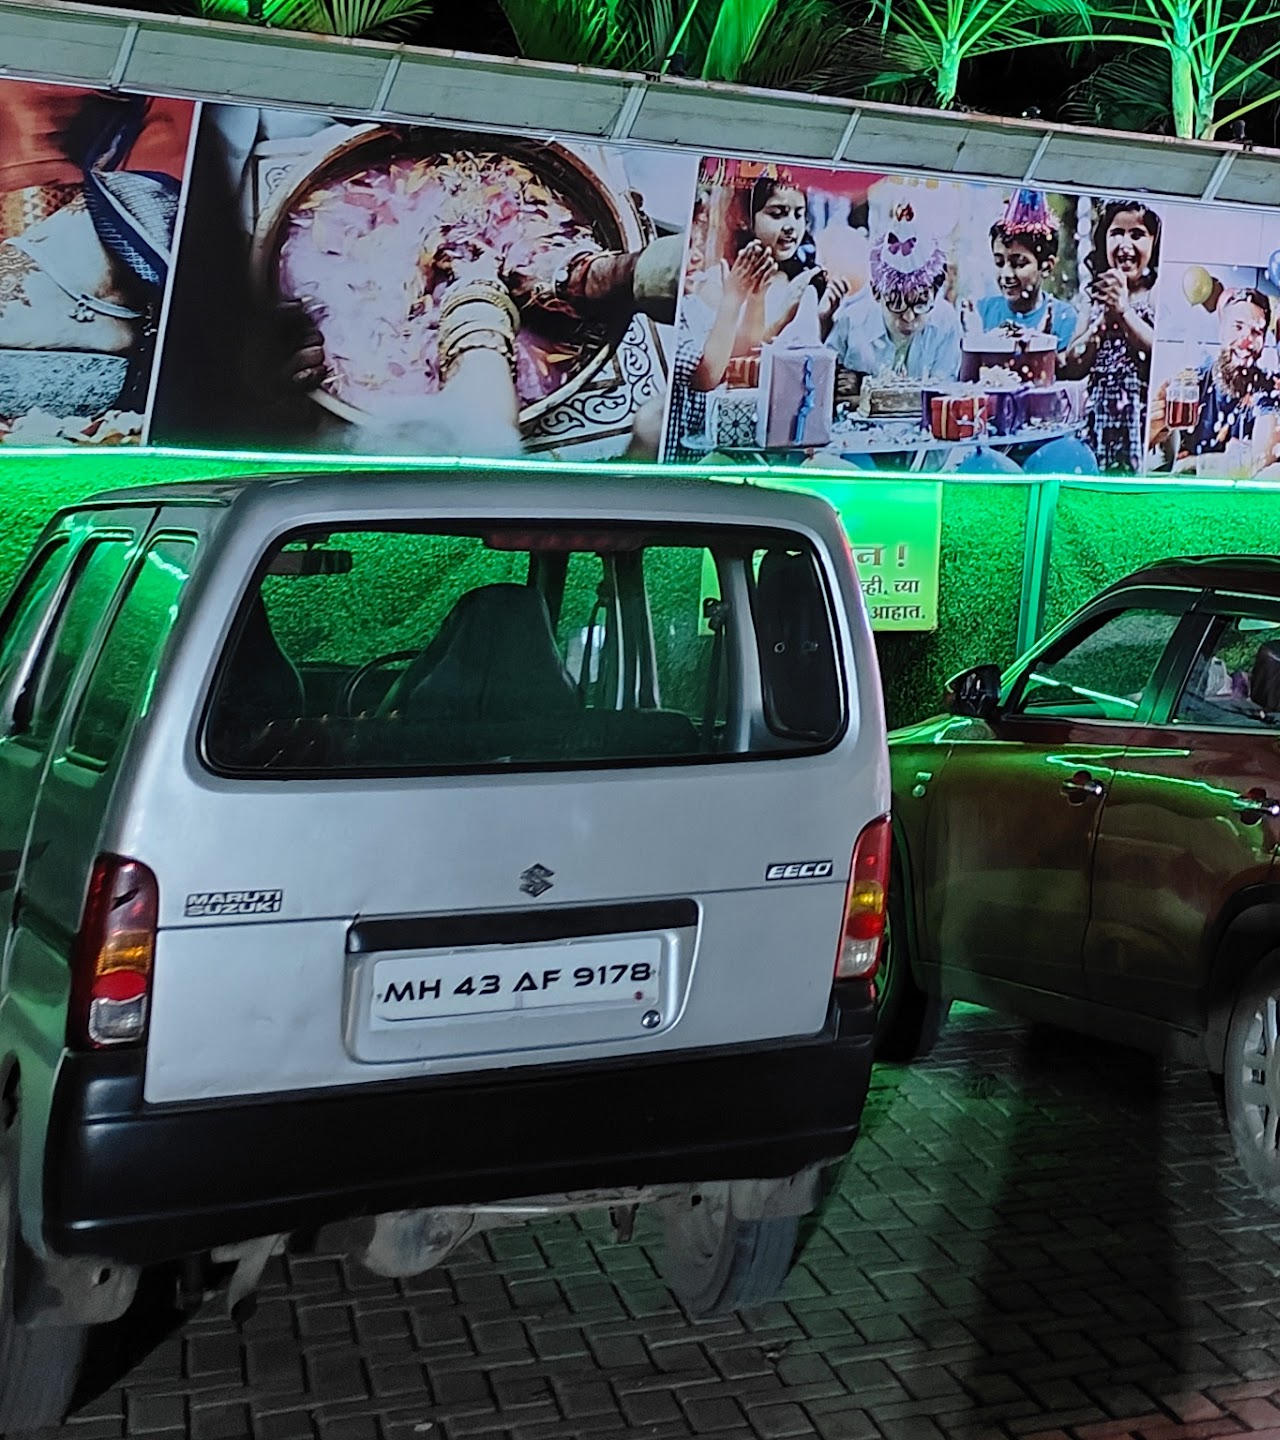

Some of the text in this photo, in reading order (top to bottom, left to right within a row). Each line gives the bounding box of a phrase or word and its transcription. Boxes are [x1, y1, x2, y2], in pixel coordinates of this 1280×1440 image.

[894, 579, 920, 594] च्या
[871, 605, 926, 621] आहात.
[767, 862, 832, 880] EECO
[188, 890, 281, 906] MARUTI
[186, 901, 280, 916] SUZUKI
[383, 962, 651, 1003] MH 43 AF 9178
